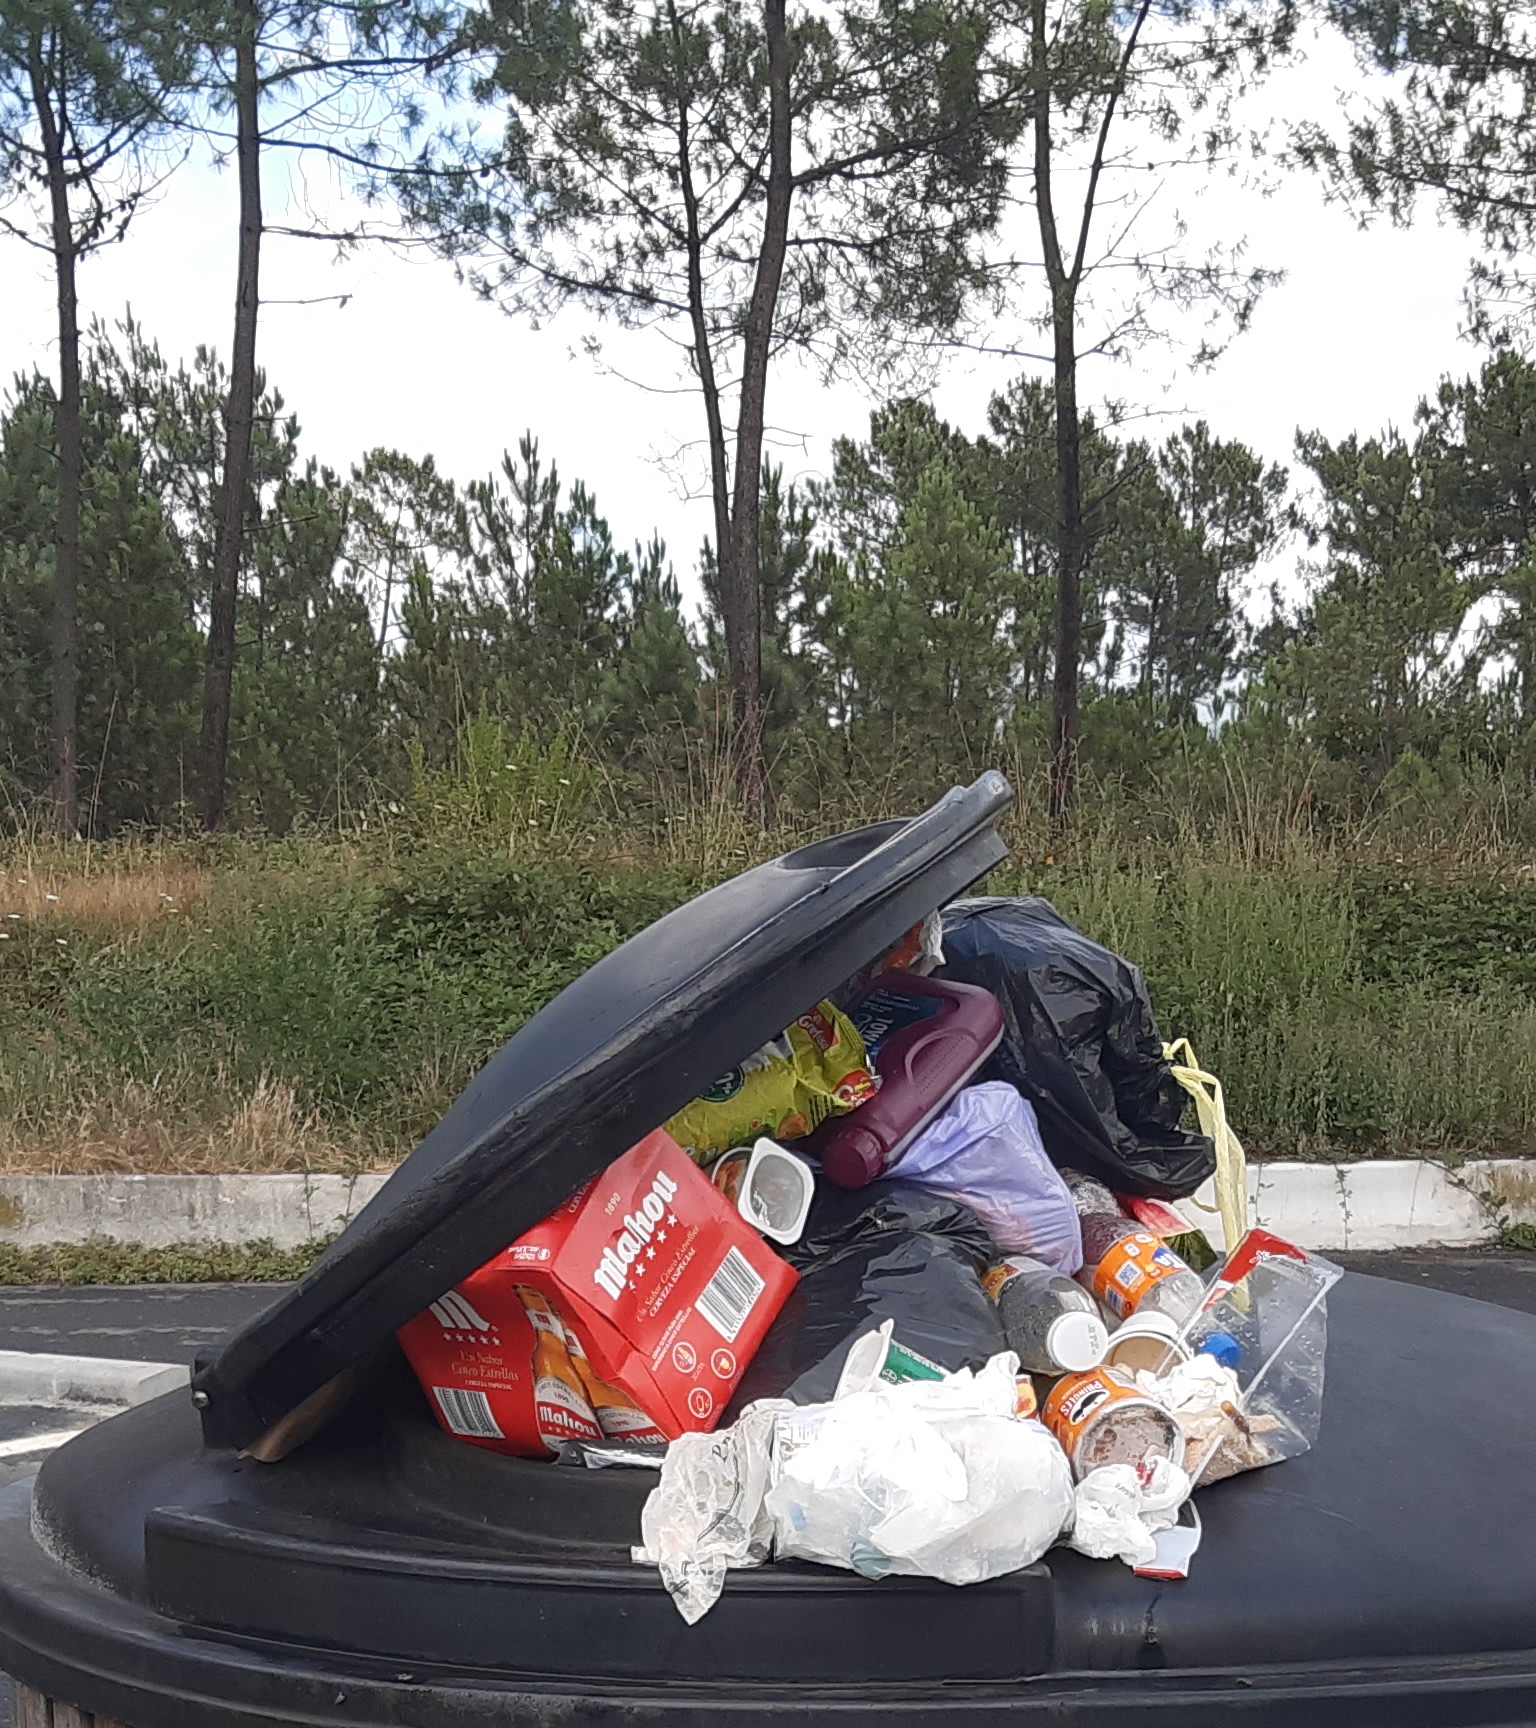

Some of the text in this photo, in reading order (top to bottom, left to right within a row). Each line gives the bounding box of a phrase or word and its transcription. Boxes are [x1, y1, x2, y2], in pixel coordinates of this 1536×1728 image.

[604, 1192, 621, 1216] 1890
[594, 1170, 678, 1300] Mahou
[540, 1405, 596, 1436] Mahou
